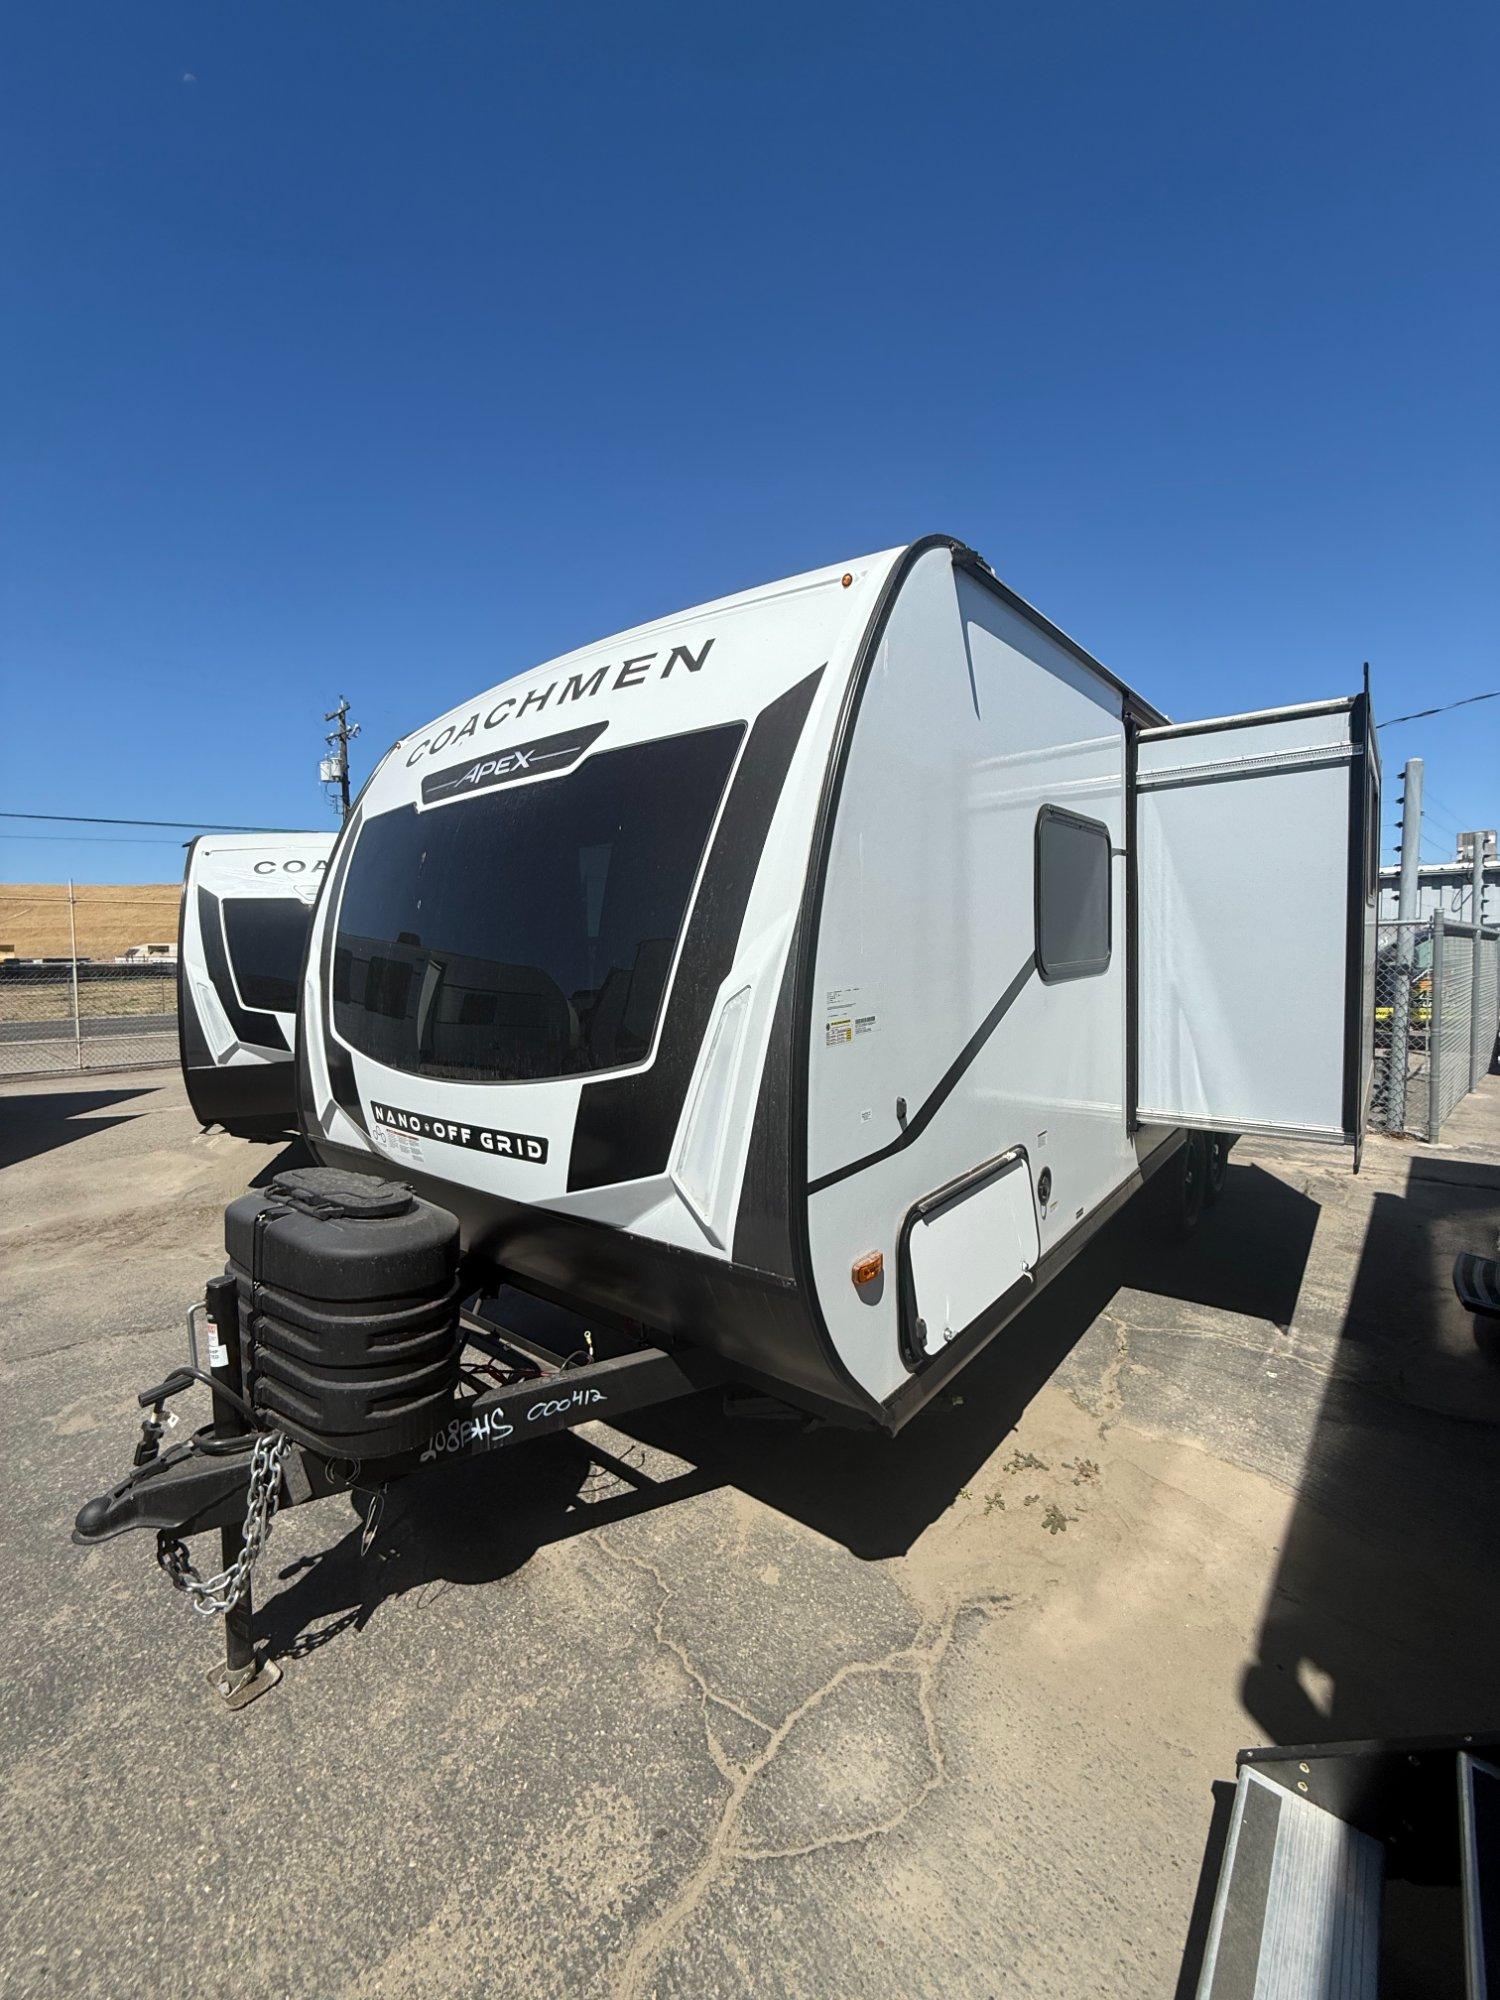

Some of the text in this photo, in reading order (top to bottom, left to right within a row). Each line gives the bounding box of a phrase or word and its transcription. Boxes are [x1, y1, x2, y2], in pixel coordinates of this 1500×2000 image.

[406, 638, 716, 767] COACHMEN
[454, 749, 535, 788] APEX
[375, 1105, 543, 1159] NANO OFF GRID
[527, 1389, 607, 1421] 000412
